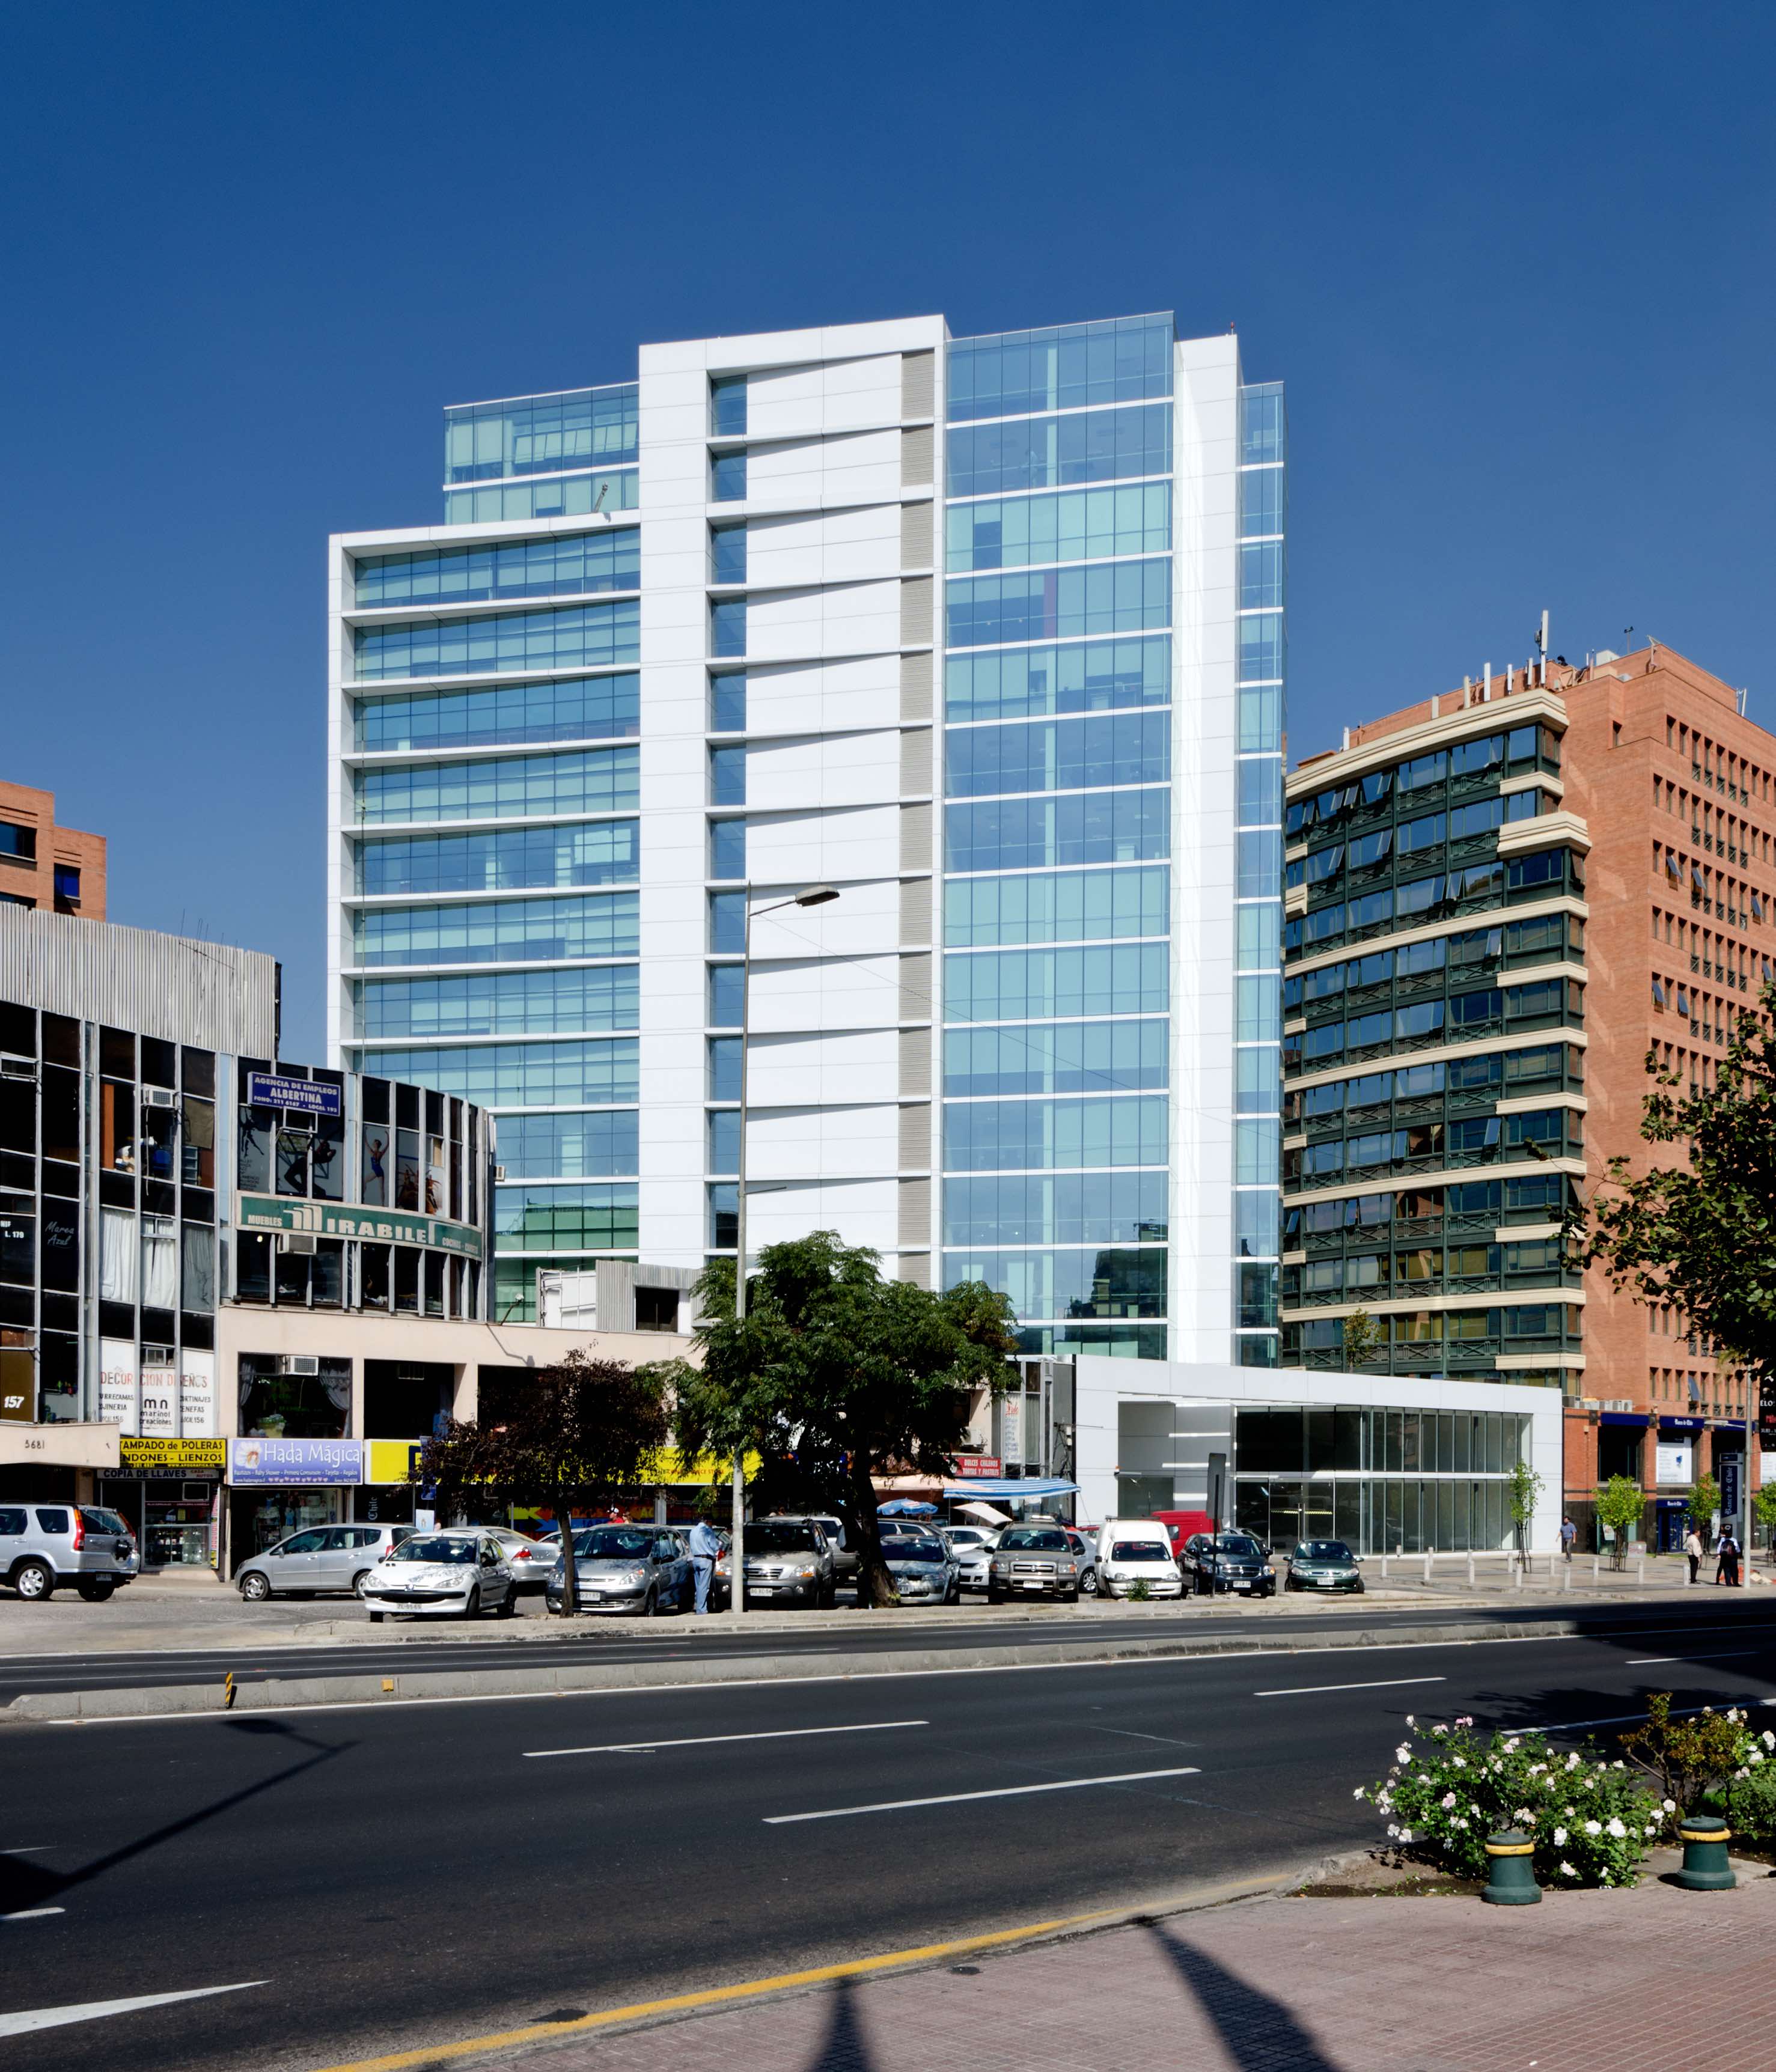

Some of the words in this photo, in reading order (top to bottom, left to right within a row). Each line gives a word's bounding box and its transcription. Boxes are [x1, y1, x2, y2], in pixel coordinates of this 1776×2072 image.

[254, 1076, 290, 1088] AGENCIA
[303, 1084, 337, 1095] EMPLEOS
[270, 1087, 322, 1104] ALBERTINA
[248, 1214, 282, 1226] MUEBLES
[100, 1371, 163, 1386] DECORCION
[4, 1395, 25, 1409] 157
[180, 1395, 211, 1403] ORTINAJES
[25, 1439, 45, 1449] 5681
[168, 1441, 178, 1449] de
[182, 1440, 222, 1449] POLERAS
[264, 1442, 303, 1464] Hada
[308, 1443, 360, 1468] Mágica
[103, 1469, 133, 1478] COPIA
[136, 1469, 149, 1478] DE
[151, 1470, 187, 1478] LLAVES
[368, 1496, 378, 1520] Chile
[1724, 1494, 1733, 1515] Banco
